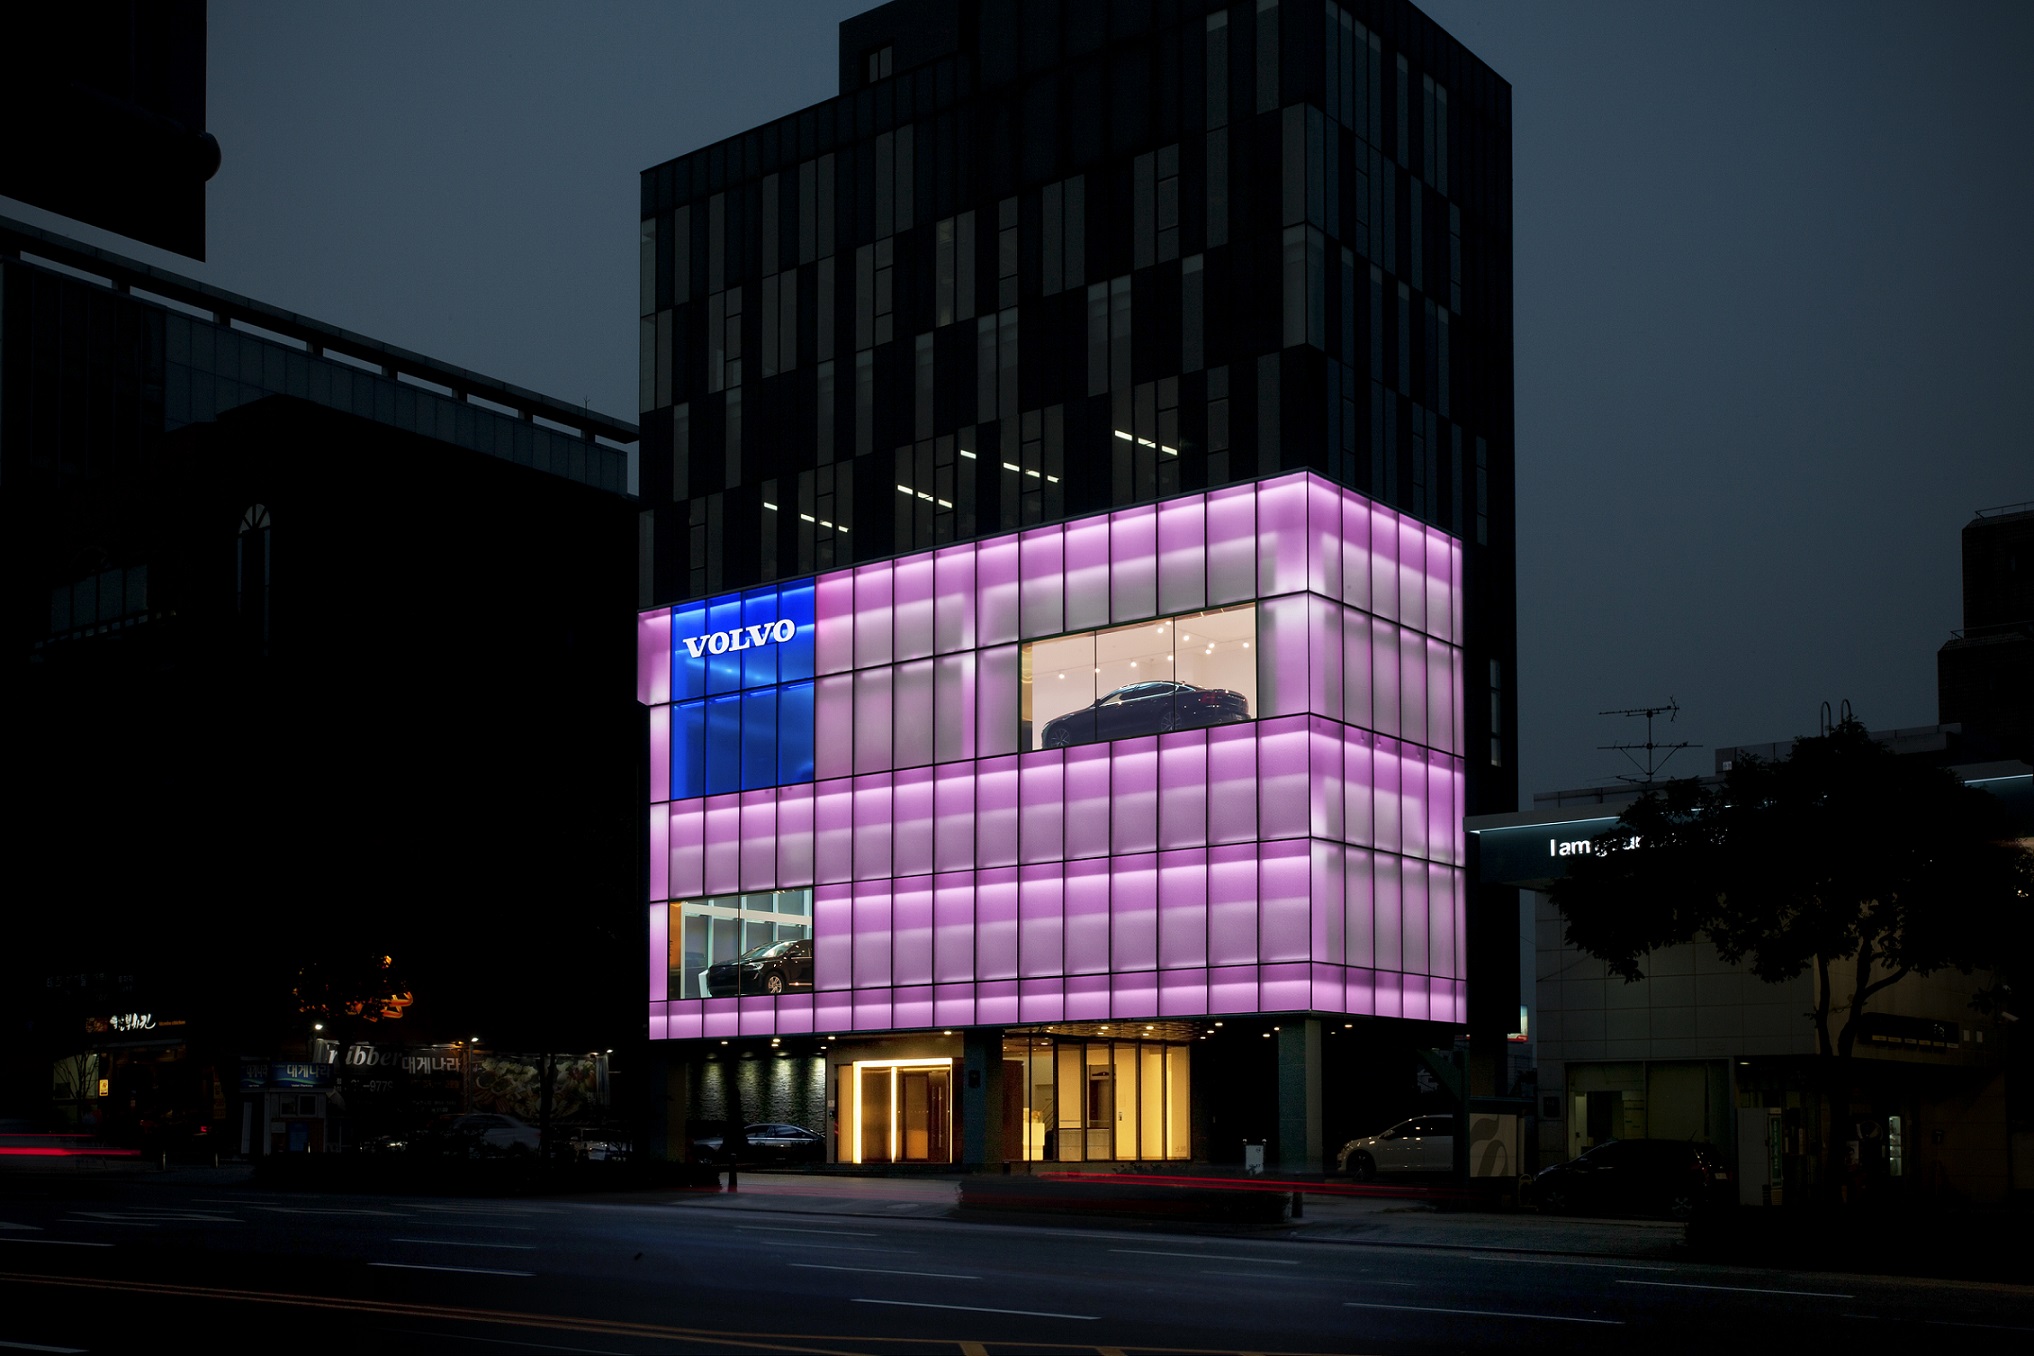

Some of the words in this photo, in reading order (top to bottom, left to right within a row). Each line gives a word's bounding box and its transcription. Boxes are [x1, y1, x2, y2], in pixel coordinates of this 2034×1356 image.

[683, 618, 796, 658] VOLVO
[1549, 838, 1556, 857] I
[1558, 839, 1591, 856] am
[286, 1064, 331, 1078] 대게나라
[401, 1056, 461, 1074] 대게나라
